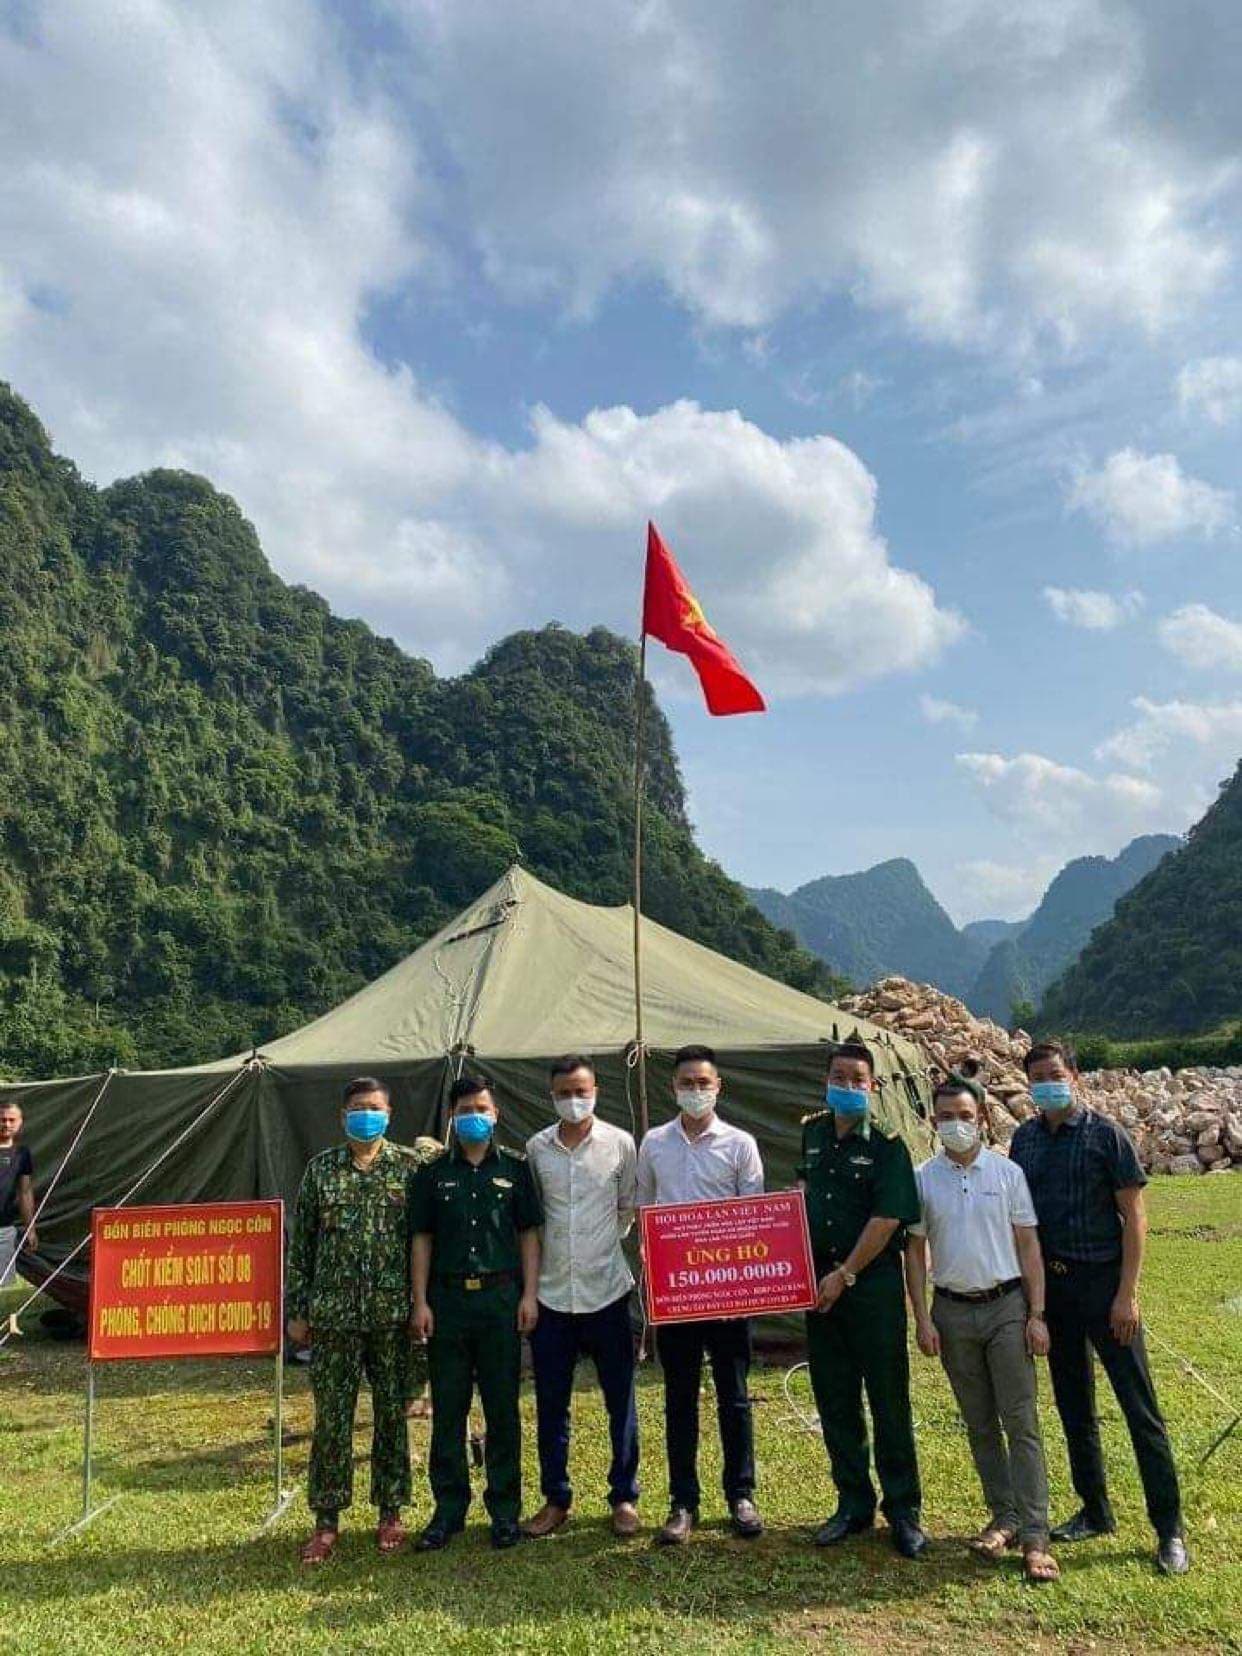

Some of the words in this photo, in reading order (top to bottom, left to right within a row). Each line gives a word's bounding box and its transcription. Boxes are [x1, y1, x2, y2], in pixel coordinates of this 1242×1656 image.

[763, 1201, 791, 1214] NAM
[208, 1216, 243, 1238] NGỌC
[737, 1239, 769, 1262] HỘ
[122, 1247, 151, 1289] CHỐT
[153, 1244, 184, 1286] KIỂM
[218, 1243, 234, 1284] SỐ
[668, 1260, 793, 1288] 150.000.000Đ
[146, 1294, 186, 1335] CHỐNG
[188, 1302, 215, 1339] DỊCH
[218, 1301, 272, 1332] COVID-19
